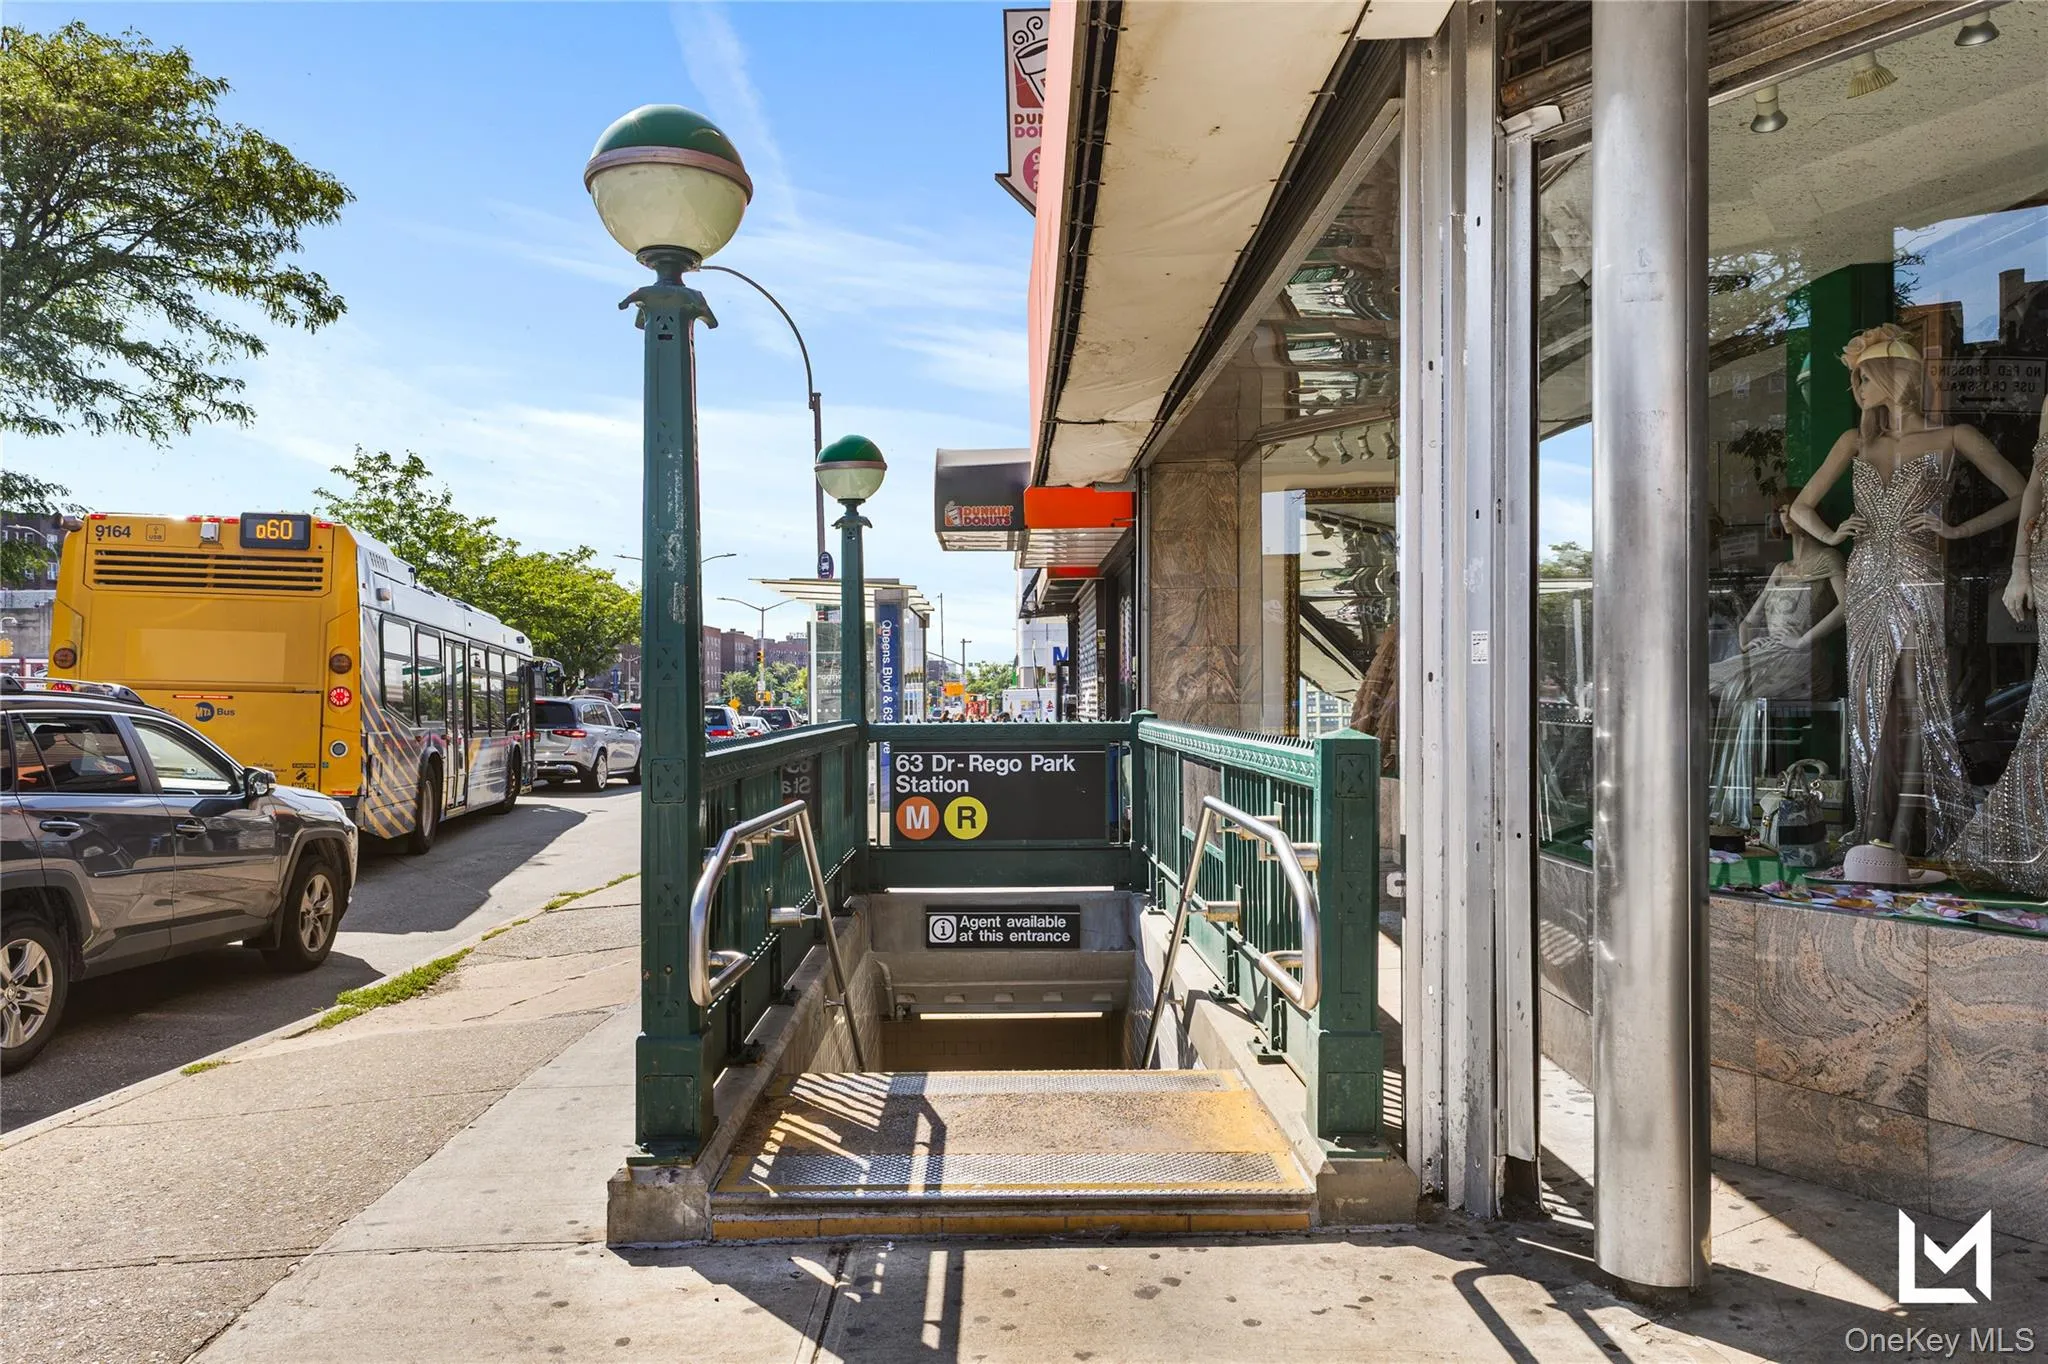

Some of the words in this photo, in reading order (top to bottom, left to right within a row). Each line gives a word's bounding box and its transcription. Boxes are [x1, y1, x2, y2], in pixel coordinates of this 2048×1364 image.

[1014, 126, 1042, 138] DO
[964, 516, 1012, 526] DONUTS
[95, 525, 131, 538] 9164
[882, 620, 892, 663] Queens
[882, 667, 893, 693] Blvd
[883, 696, 893, 704] &
[216, 708, 235, 716] Bus
[895, 755, 924, 772] 63
[1030, 754, 1076, 772] Park
[895, 775, 969, 793] Station
[906, 805, 930, 829] M
[957, 805, 977, 829] R
[959, 915, 1001, 932] Agent
[1006, 915, 1066, 928] available
[959, 931, 974, 942] at
[978, 929, 1004, 942] this
[1009, 931, 1071, 942] entrance
